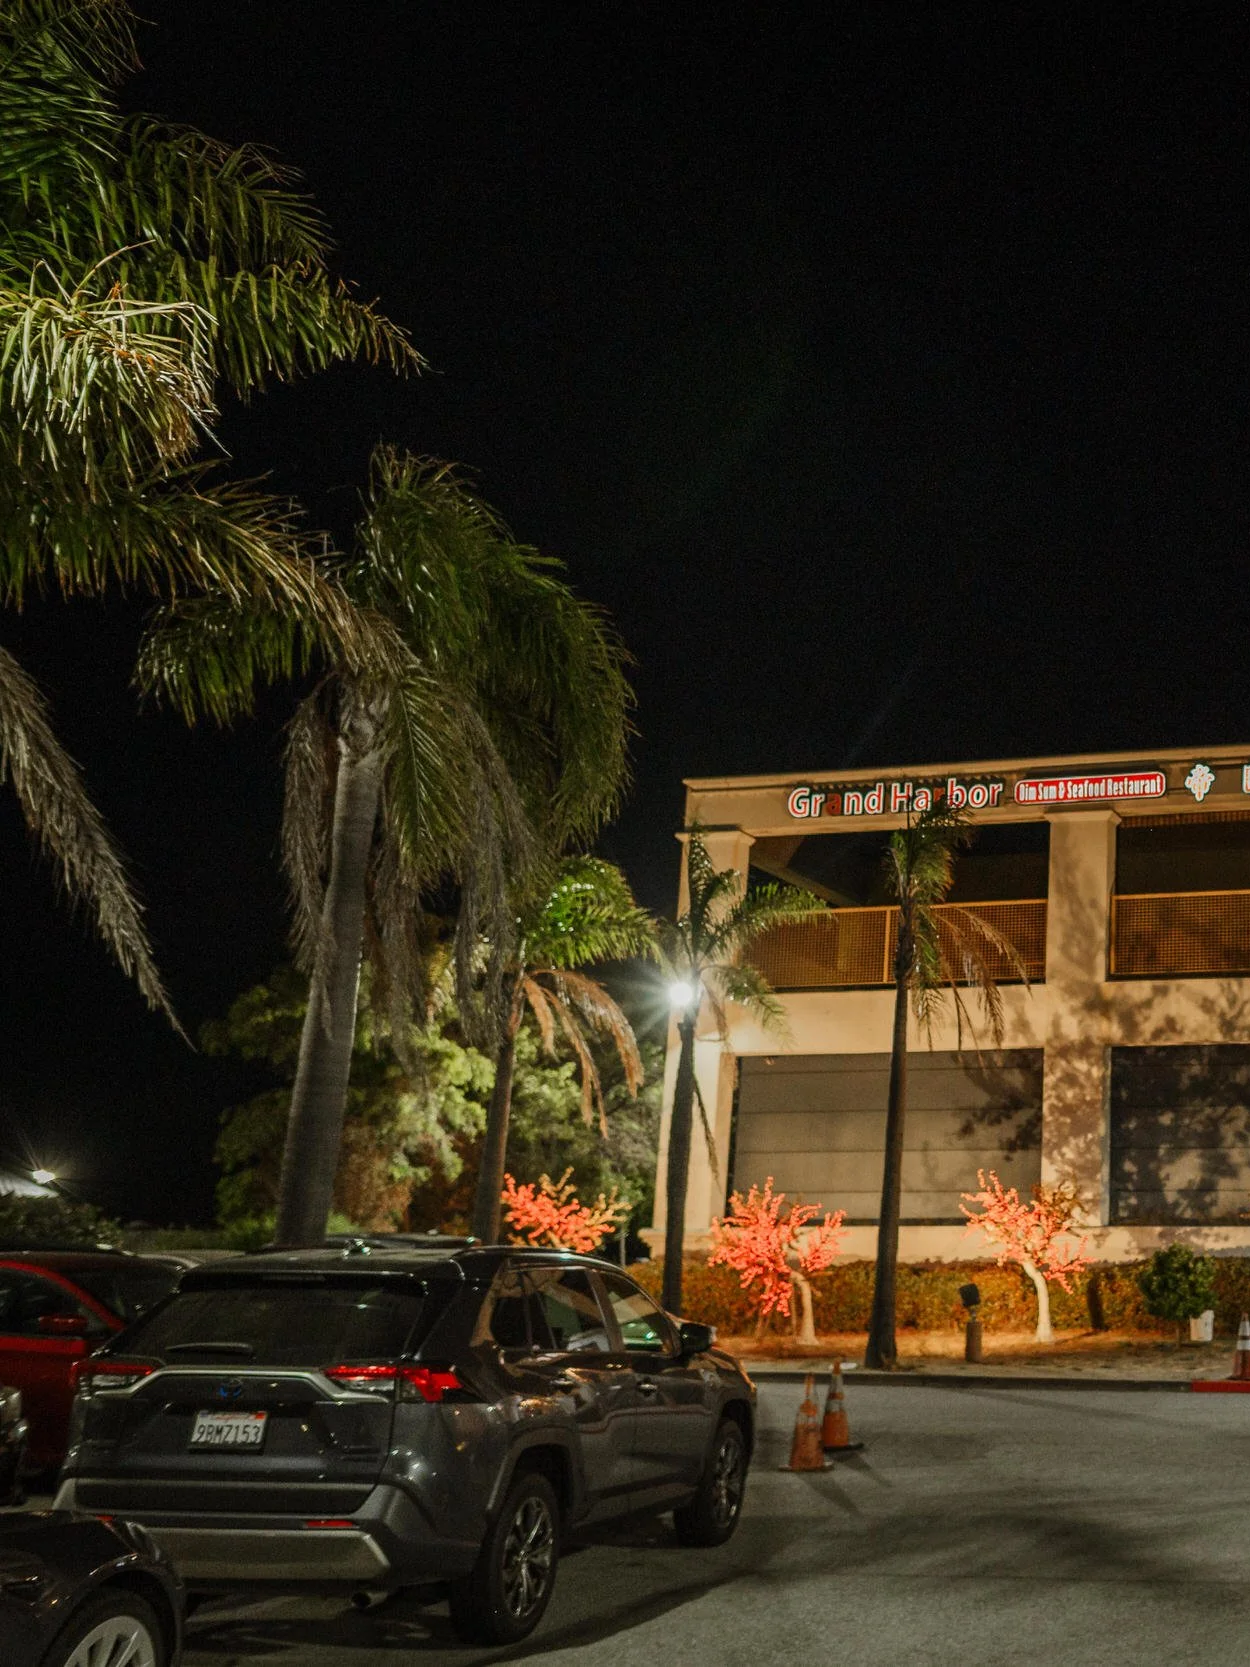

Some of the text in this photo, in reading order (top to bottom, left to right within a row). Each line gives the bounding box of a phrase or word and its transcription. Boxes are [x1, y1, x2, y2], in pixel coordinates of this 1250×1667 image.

[788, 783, 884, 818] Grand
[1019, 775, 1161, 801] Dim Sum & Seafood Restaurant
